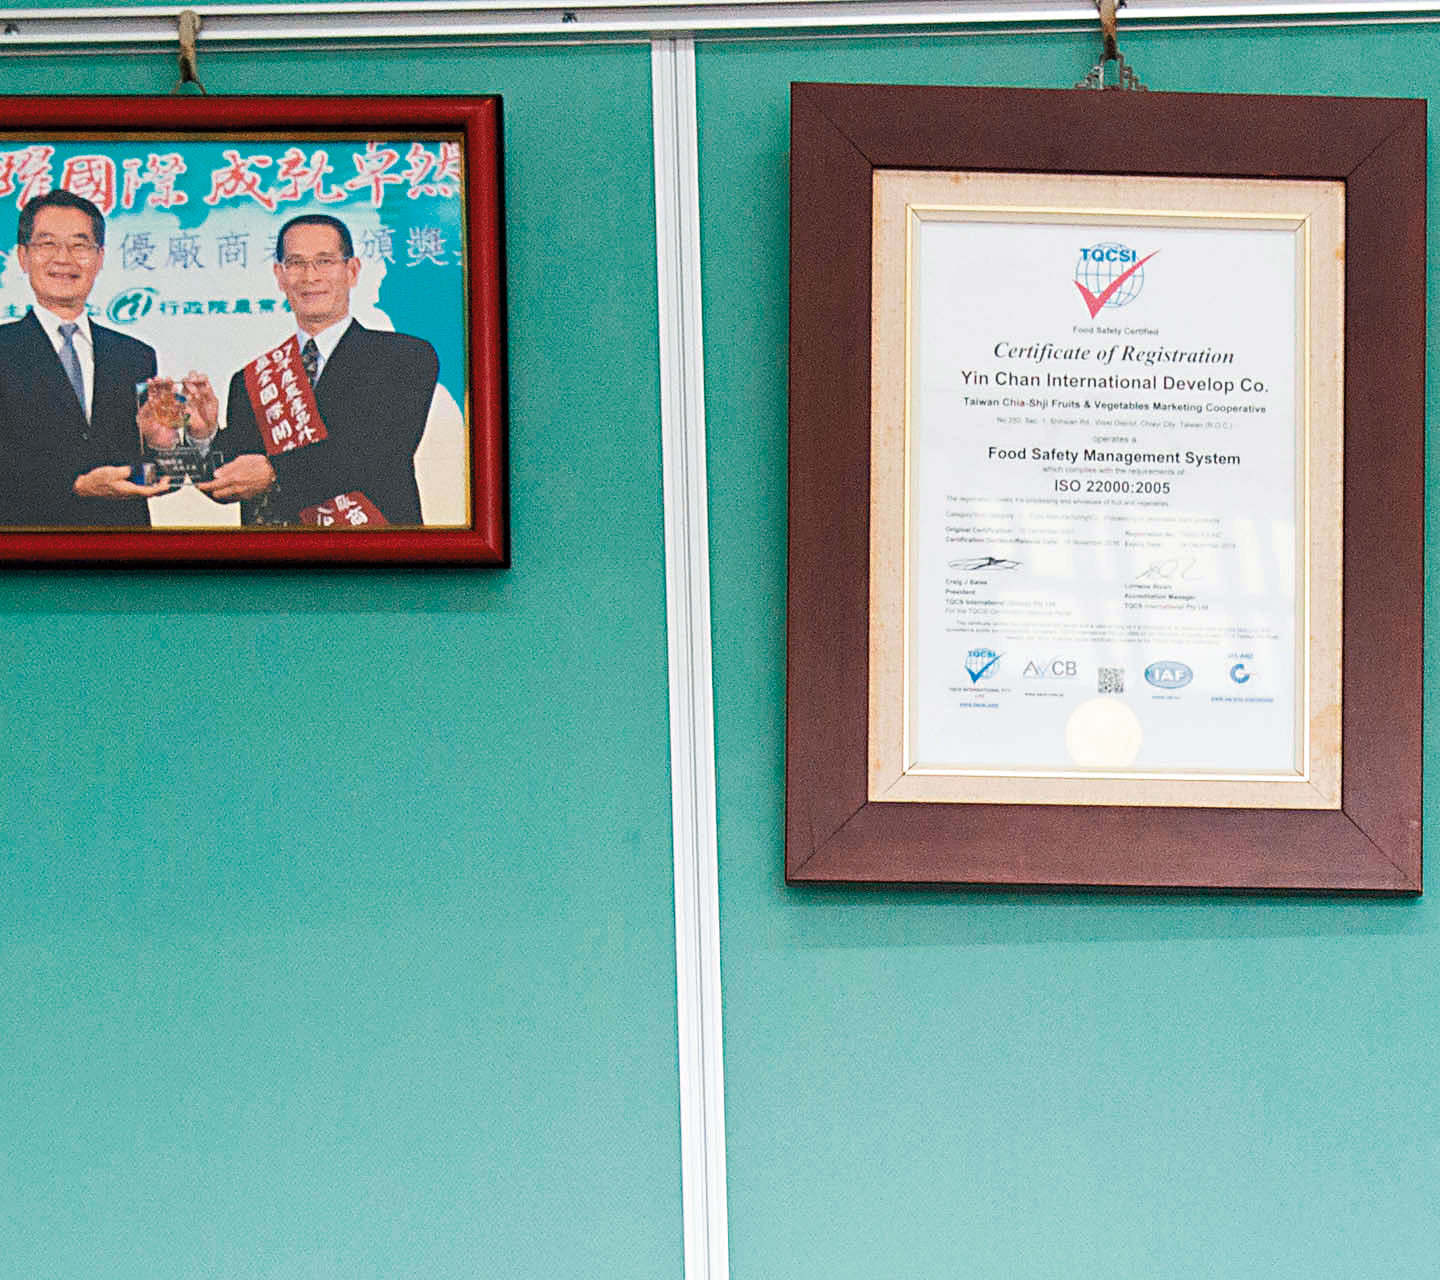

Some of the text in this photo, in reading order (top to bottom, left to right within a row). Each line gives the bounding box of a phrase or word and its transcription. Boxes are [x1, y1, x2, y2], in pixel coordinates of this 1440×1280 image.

[1079, 247, 1138, 263] TQCSI
[993, 342, 1234, 366] Certificate of Registration
[961, 370, 1270, 396] Yin Chan International Develop Co.
[988, 446, 1241, 468] Food Safety Management System
[1054, 479, 1171, 495] ISO 22000:2005
